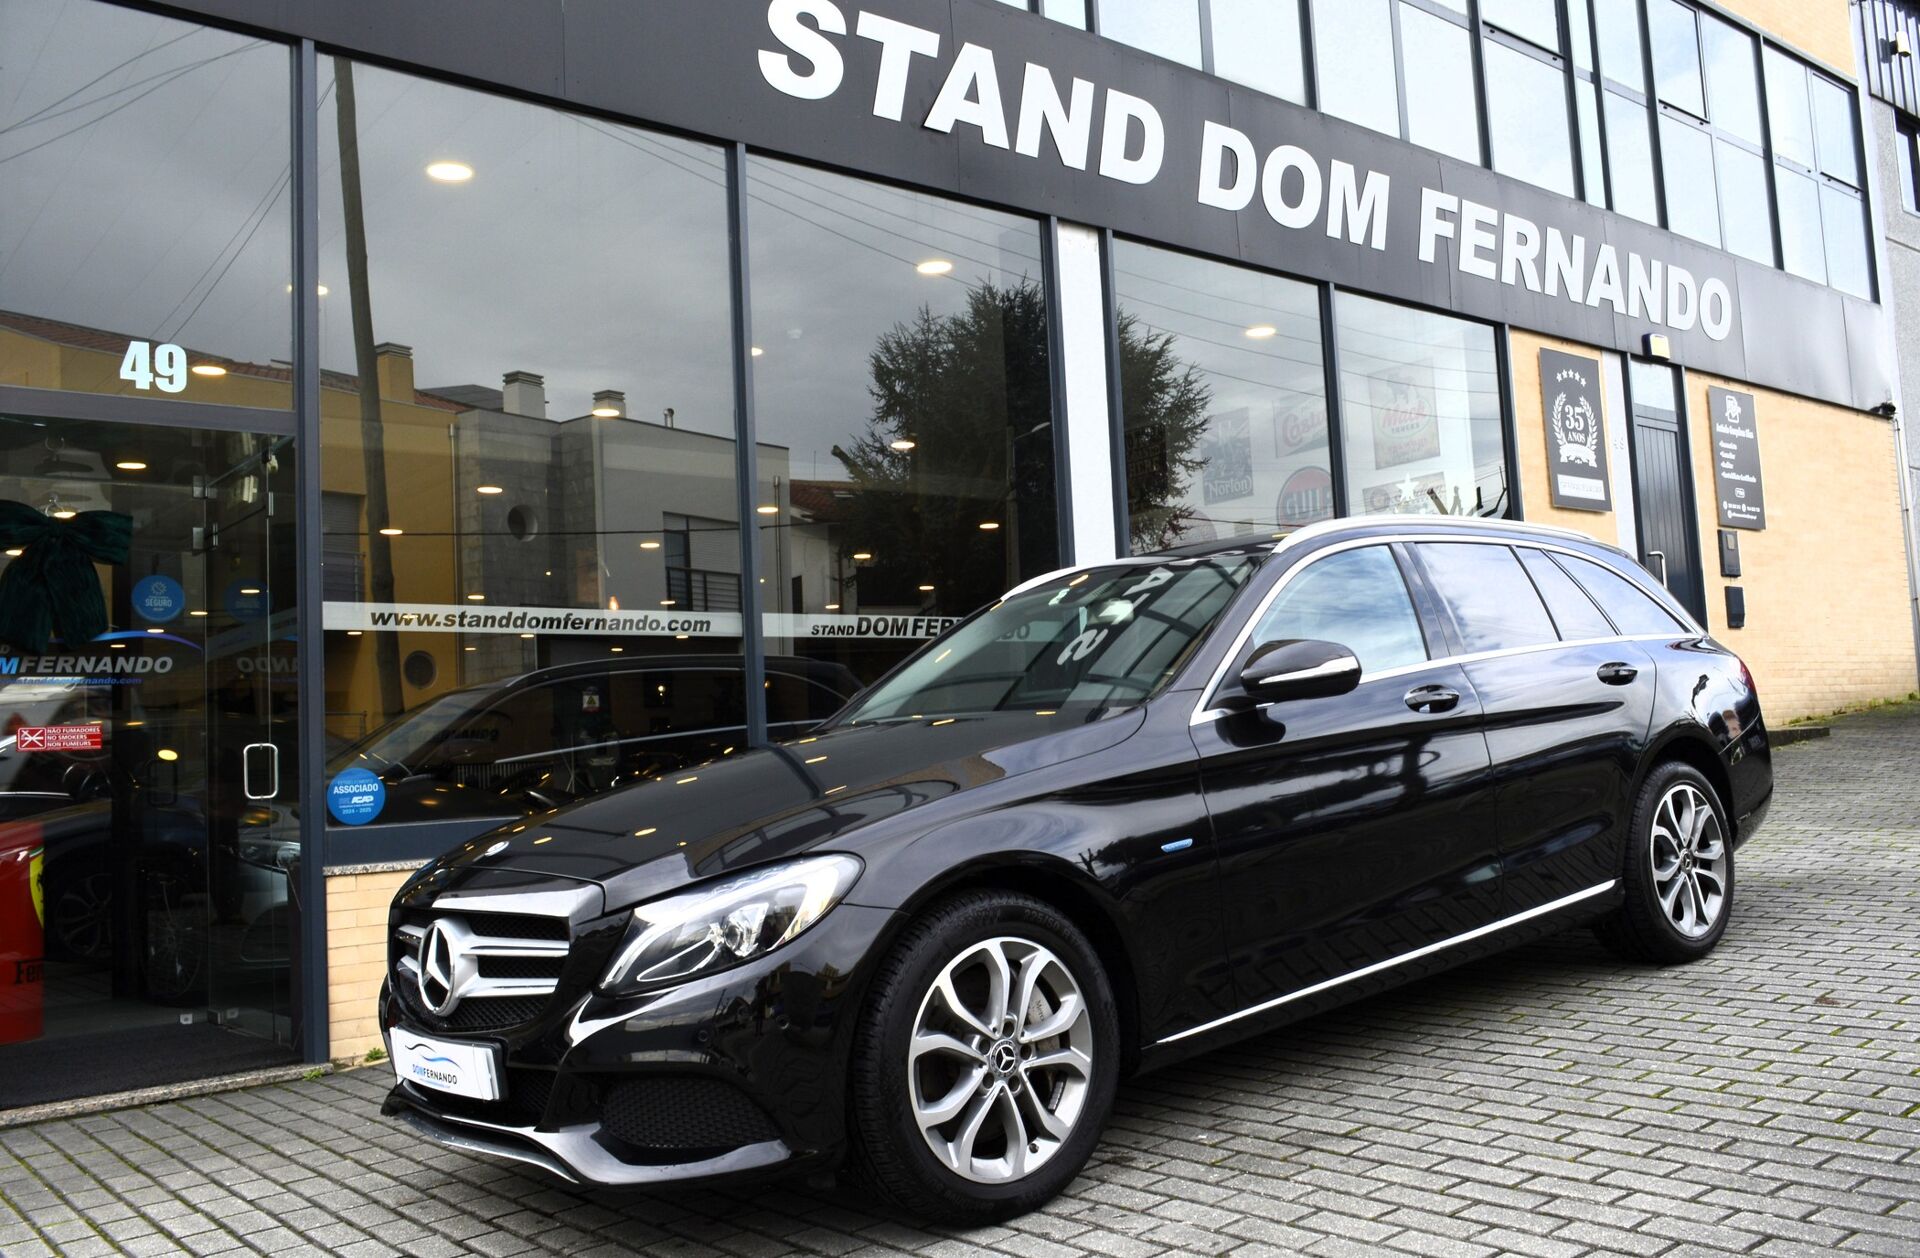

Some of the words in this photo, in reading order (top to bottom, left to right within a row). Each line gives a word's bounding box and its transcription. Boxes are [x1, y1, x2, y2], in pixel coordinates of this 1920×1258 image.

[758, 0, 1164, 185] STAND
[1198, 120, 1390, 251] DOM
[1418, 187, 1732, 342] FERNANDO
[119, 340, 187, 394] 49
[1564, 404, 1585, 431] 35
[1204, 476, 1253, 499] Norton
[145, 598, 172, 608] SEGURO
[370, 609, 711, 632] www.standdomfernando.com
[62, 726, 100, 734] FUMADORES
[333, 783, 379, 795] ASSOCIADO
